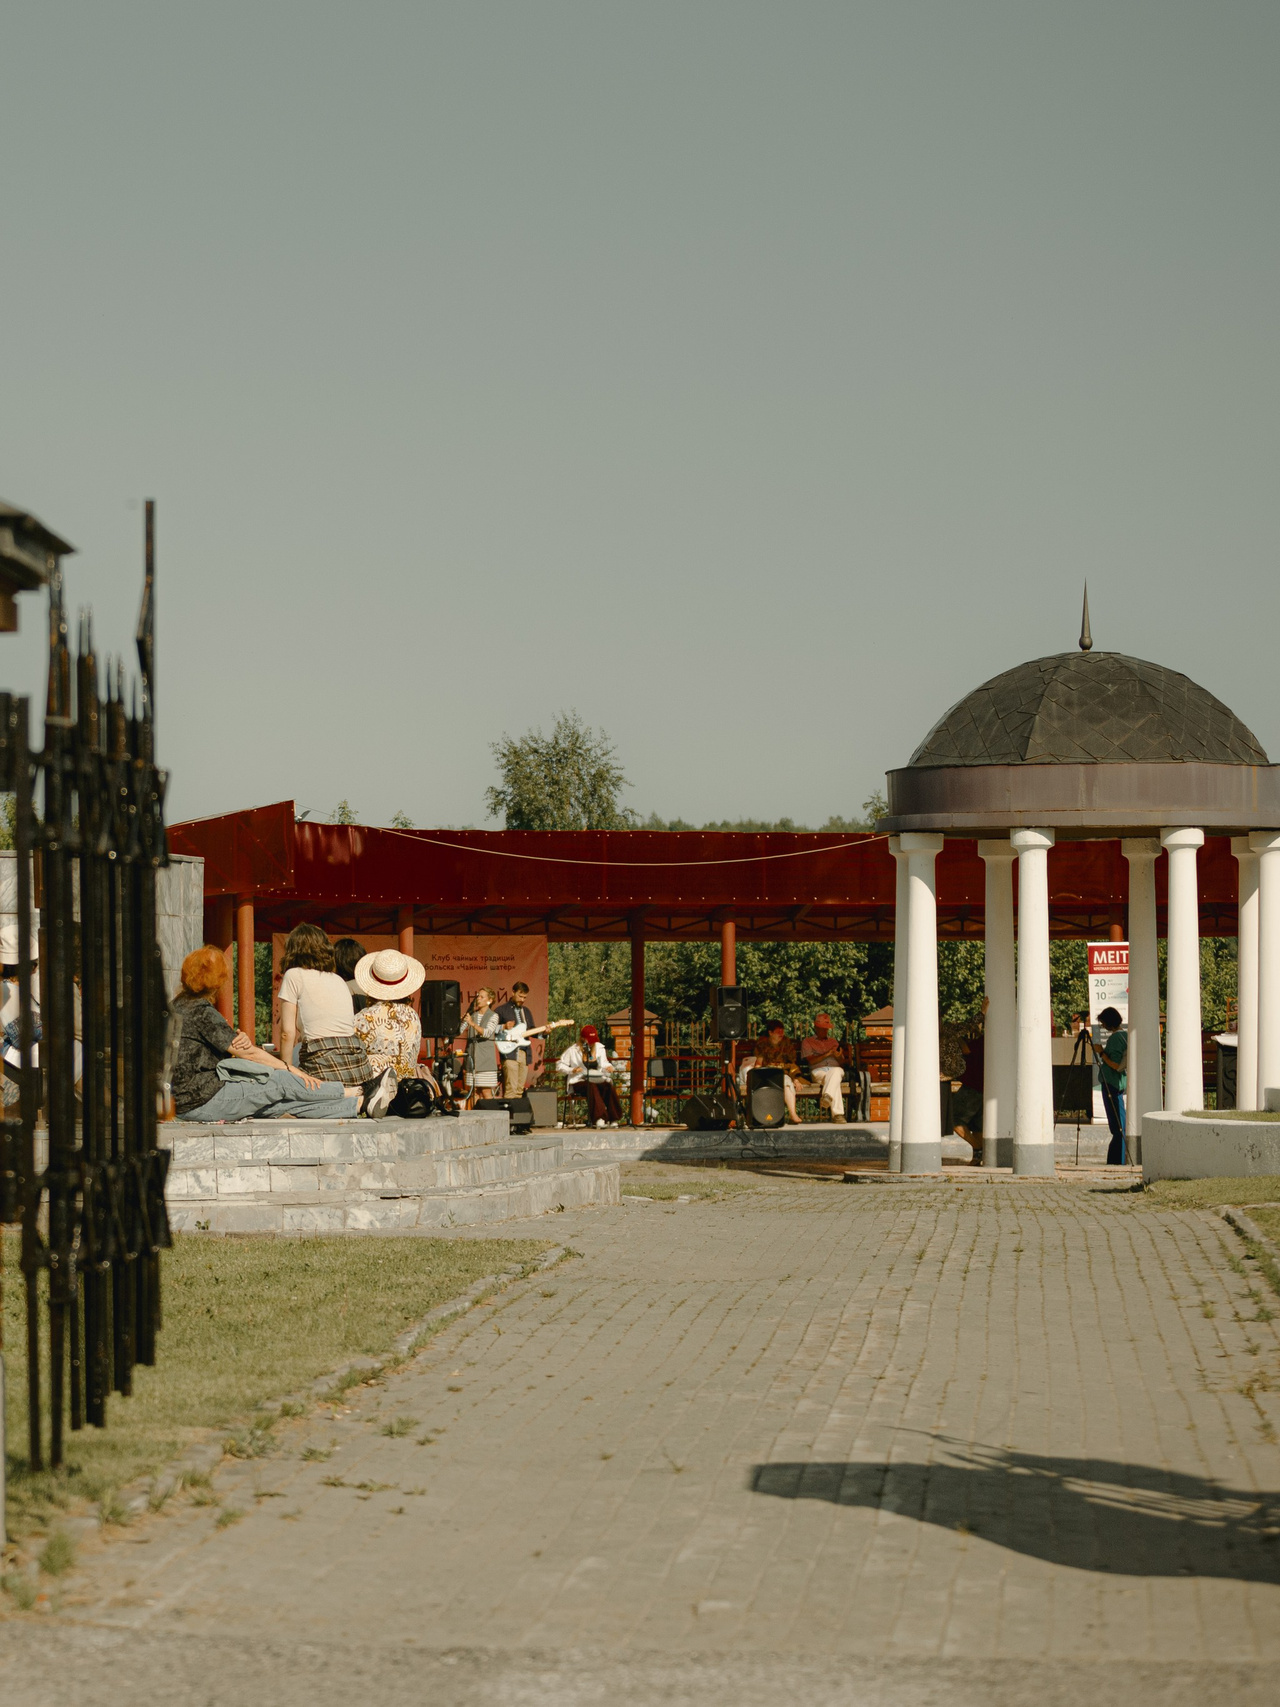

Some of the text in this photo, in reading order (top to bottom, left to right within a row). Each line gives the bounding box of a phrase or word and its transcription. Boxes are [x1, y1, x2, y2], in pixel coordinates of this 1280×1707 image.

[431, 954, 515, 962] Клуб чайных традиций
[1093, 950, 1129, 964] MEIT
[424, 963, 455, 971] больска
[457, 963, 488, 971] «Чайный
[1094, 979, 1106, 987] 20
[1096, 991, 1106, 1000] 10
